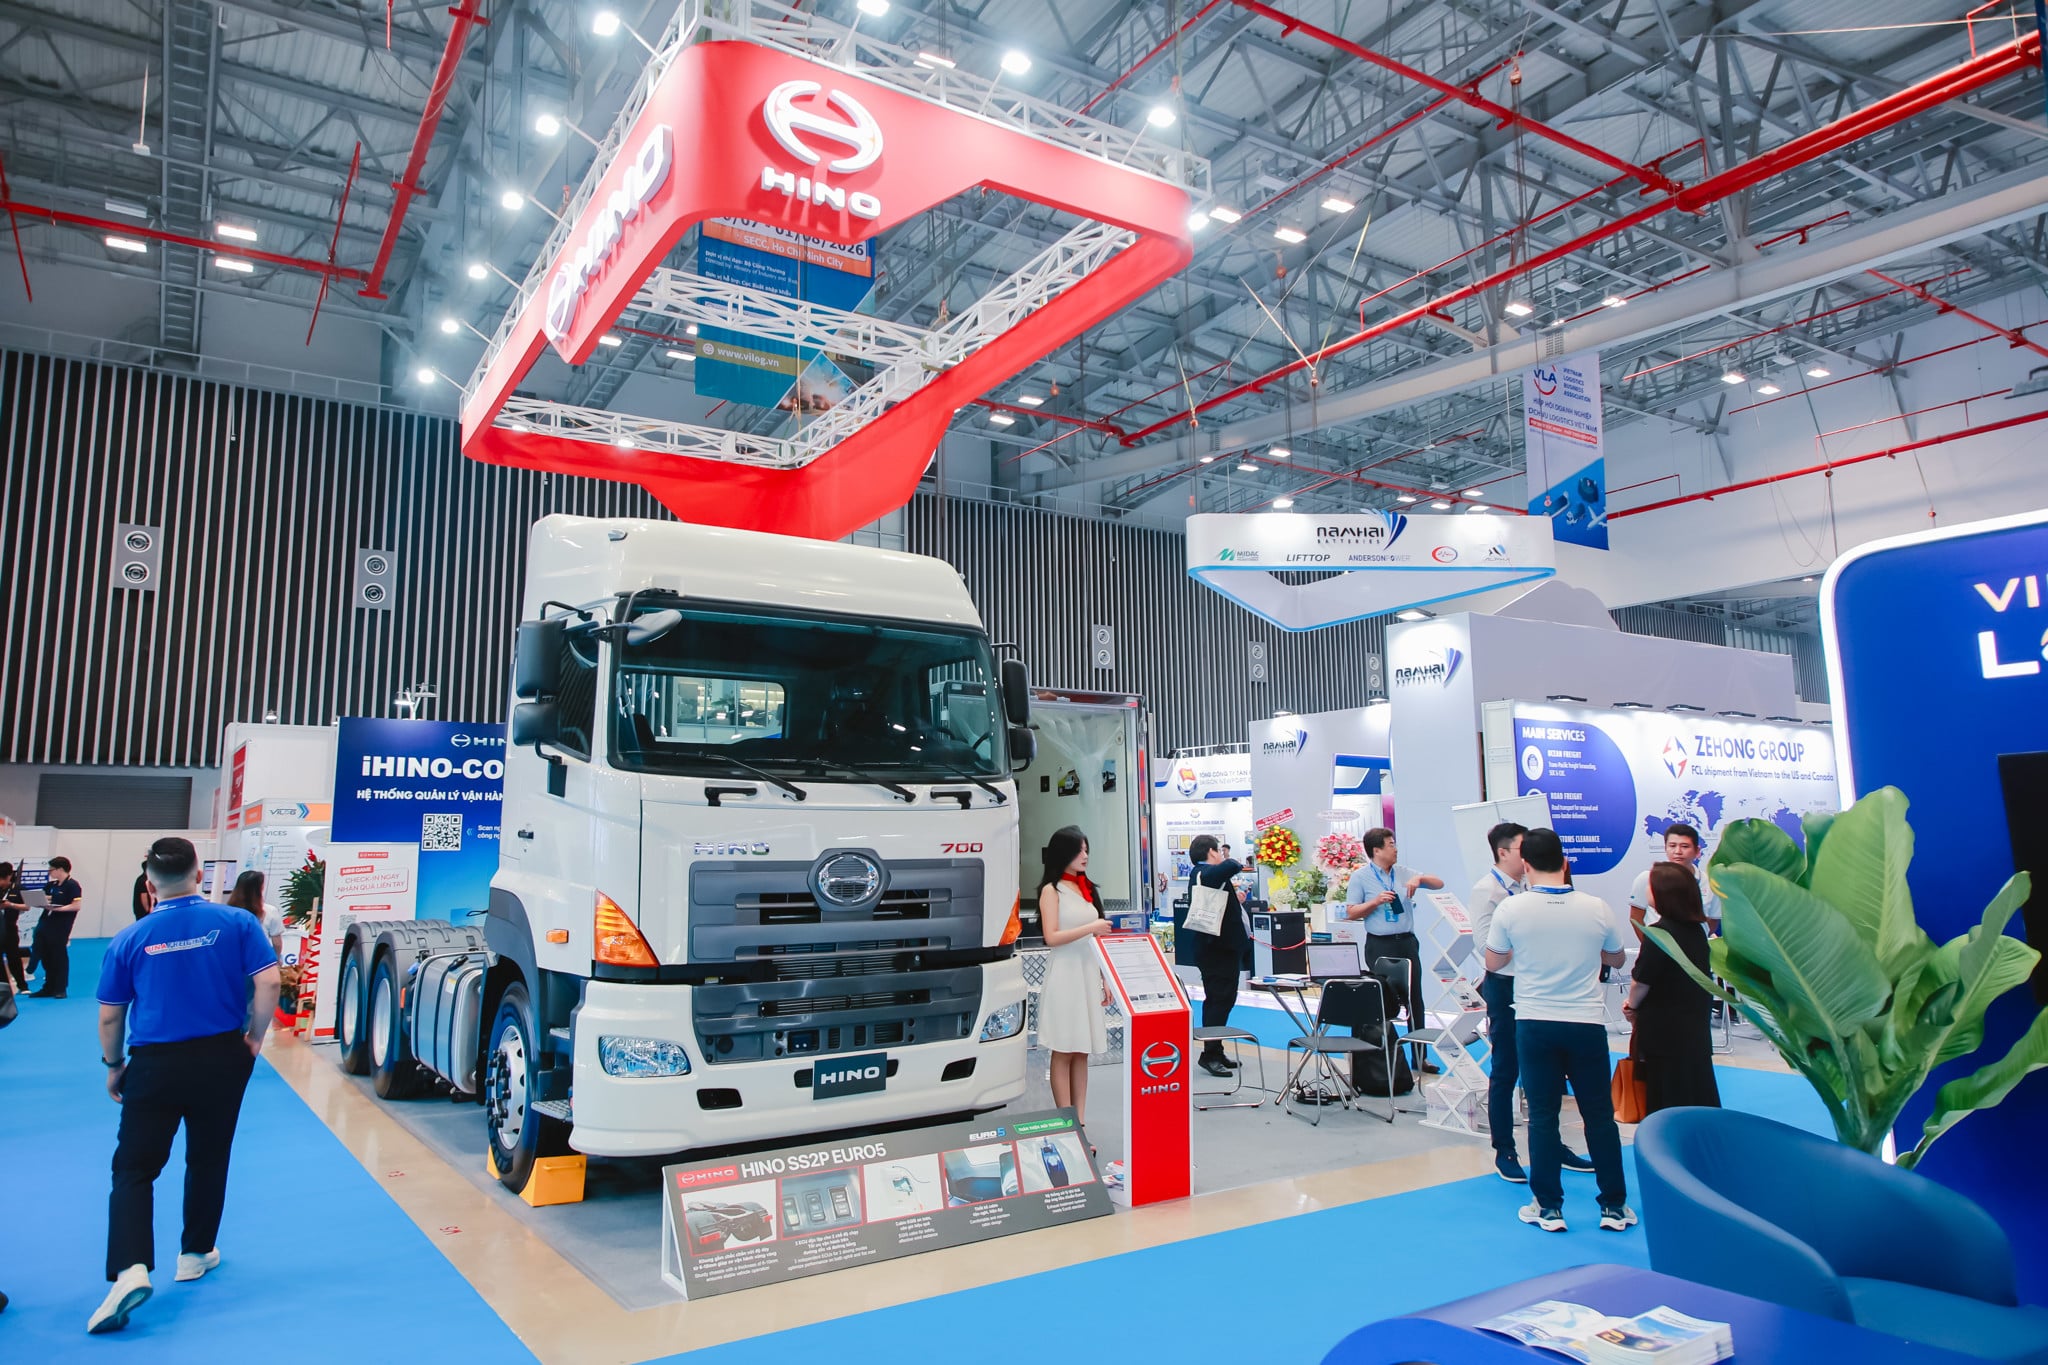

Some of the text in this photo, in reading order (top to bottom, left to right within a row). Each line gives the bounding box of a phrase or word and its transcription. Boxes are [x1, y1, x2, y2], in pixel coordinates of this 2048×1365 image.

[762, 167, 881, 220] HINO
[743, 235, 770, 250] SECC,
[827, 255, 844, 269] City
[717, 346, 780, 367] www.vilog.vn
[1534, 368, 1557, 385] VLA
[1286, 554, 1331, 562] LIFTTOP
[1973, 575, 2048, 612] VI
[1522, 726, 1586, 742] MAIN SERVICES
[1695, 735, 1805, 762] ZEHONG GROUP
[362, 756, 504, 780] iHINO-CO
[1691, 765, 1703, 775] FCL
[1704, 766, 1732, 779] shipment
[1733, 766, 1748, 777] from
[1748, 767, 1773, 778] Vietnam
[1774, 769, 1780, 779] to
[1781, 770, 1790, 779] the
[1800, 771, 1811, 780] and
[1812, 771, 1834, 781] Canada
[357, 788, 371, 801] HỆ
[373, 787, 413, 800] THỐNG
[415, 789, 446, 801] QUẢN
[448, 790, 460, 800] LÝ
[461, 790, 483, 803] VẬN
[693, 842, 770, 855] HINO
[940, 842, 984, 854] 700
[345, 873, 400, 884] CHECK-IN NGAY
[820, 1065, 881, 1085] HINO
[1141, 1081, 1181, 1095] HINO
[741, 1142, 887, 1179] HINO SS2P EURO5
[696, 1169, 735, 1180] HINO
